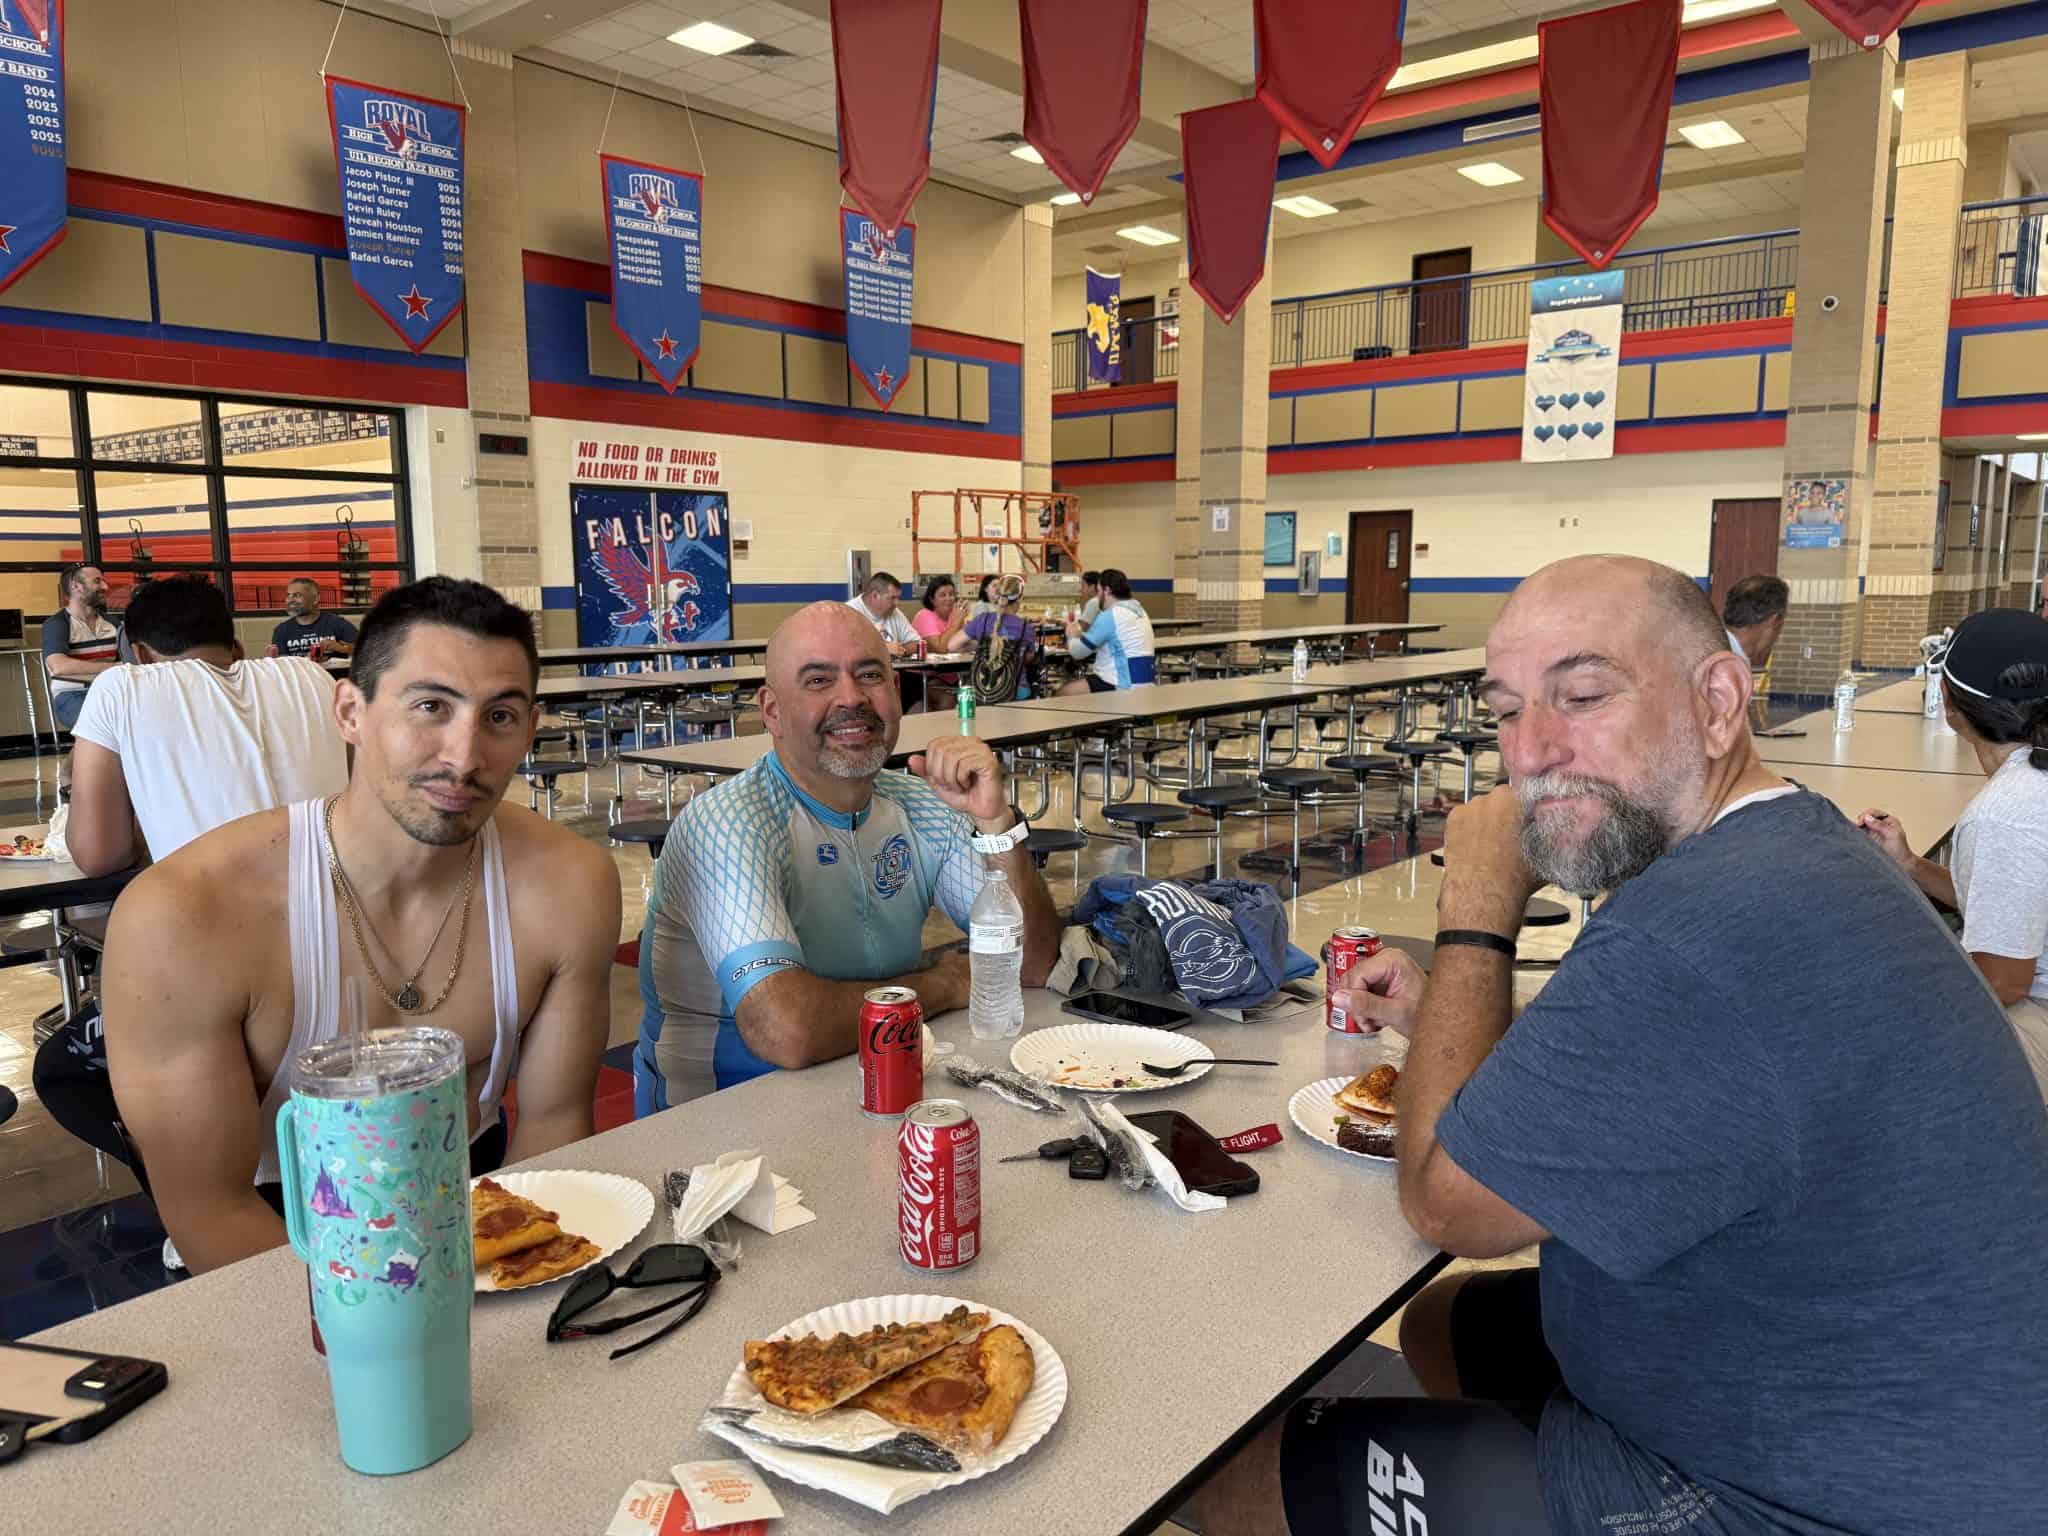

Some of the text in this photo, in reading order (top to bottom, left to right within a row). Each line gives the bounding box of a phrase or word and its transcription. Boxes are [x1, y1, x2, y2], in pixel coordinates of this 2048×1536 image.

[8, 62, 48, 79] BAND
[24, 84, 55, 99] 2024
[26, 98, 58, 113] 2025
[28, 114, 60, 128] 2025
[364, 100, 431, 141] ROYAL
[31, 129, 63, 143] 2025
[348, 128, 454, 159] HIGH SCHOOL
[345, 166, 373, 178] Jacob
[349, 150, 455, 179] UIL REGION JAZZ BAND
[346, 178, 379, 192] Joseph
[382, 184, 411, 197] Turner
[629, 174, 678, 207] ROYAL
[346, 190, 375, 203] Rafael
[378, 195, 409, 209] Garces
[347, 202, 374, 215] Devin
[376, 207, 401, 220] Ruley
[385, 220, 424, 234] Houston
[349, 226, 384, 240] Damien
[386, 232, 421, 246] Ramirez
[616, 233, 659, 247] Sweepstakes
[618, 243, 660, 257] Sweepstakes
[351, 251, 381, 263] Rafael
[383, 255, 414, 268] Garces
[618, 252, 661, 266] Sweepstakes
[619, 262, 662, 276] Sweepstakes
[620, 271, 663, 286] Sweepstakes
[578, 441, 717, 466] NO FOOD OR DRINKS
[577, 462, 720, 486] ALLOWED IN THE GYM
[586, 507, 722, 550] FALCON
[1230, 1132, 1261, 1148] FLIGHT
